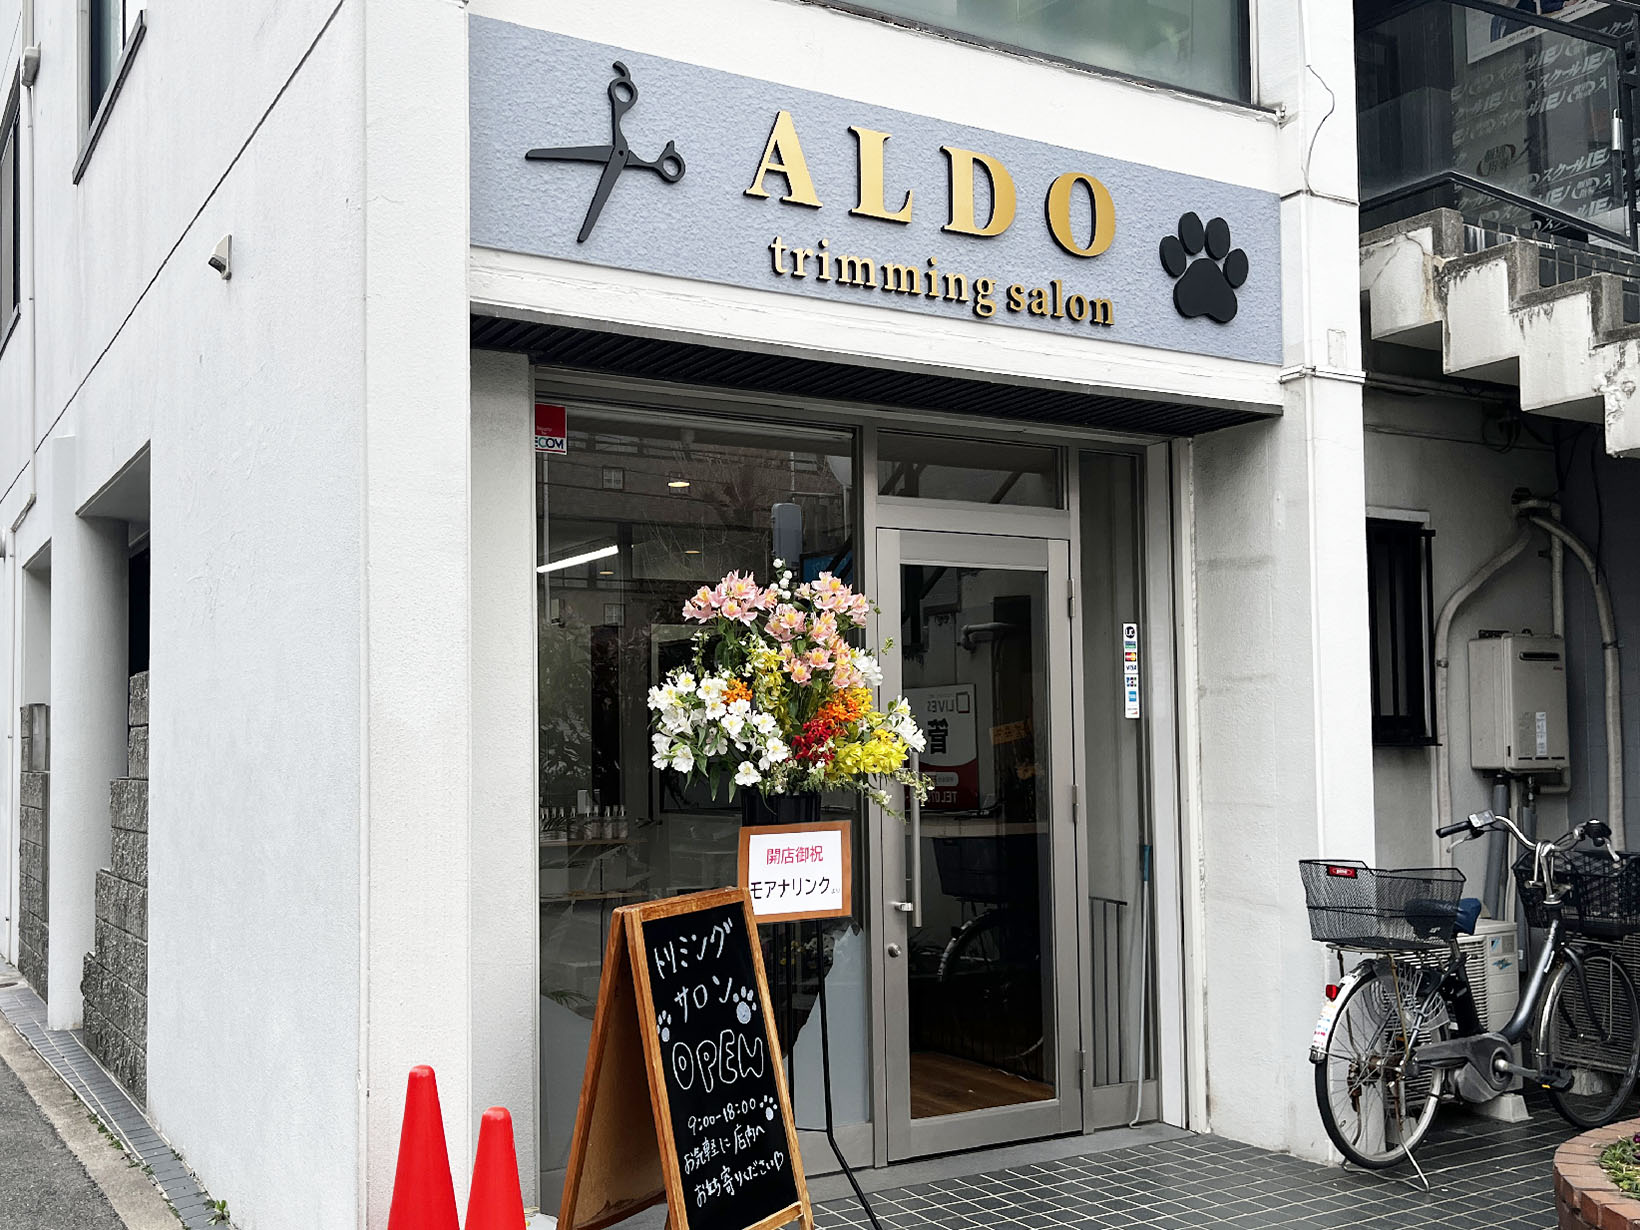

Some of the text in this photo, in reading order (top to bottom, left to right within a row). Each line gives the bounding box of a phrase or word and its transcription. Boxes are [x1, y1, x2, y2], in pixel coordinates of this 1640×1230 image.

[744, 110, 1117, 258] ALDO
[770, 235, 1115, 326] trimming salon
[766, 845, 824, 865] 開店御祝
[750, 876, 830, 899] モアナリンク
[654, 917, 733, 979] トリミング
[674, 975, 733, 1023] サロン
[672, 1029, 764, 1093] OPEN
